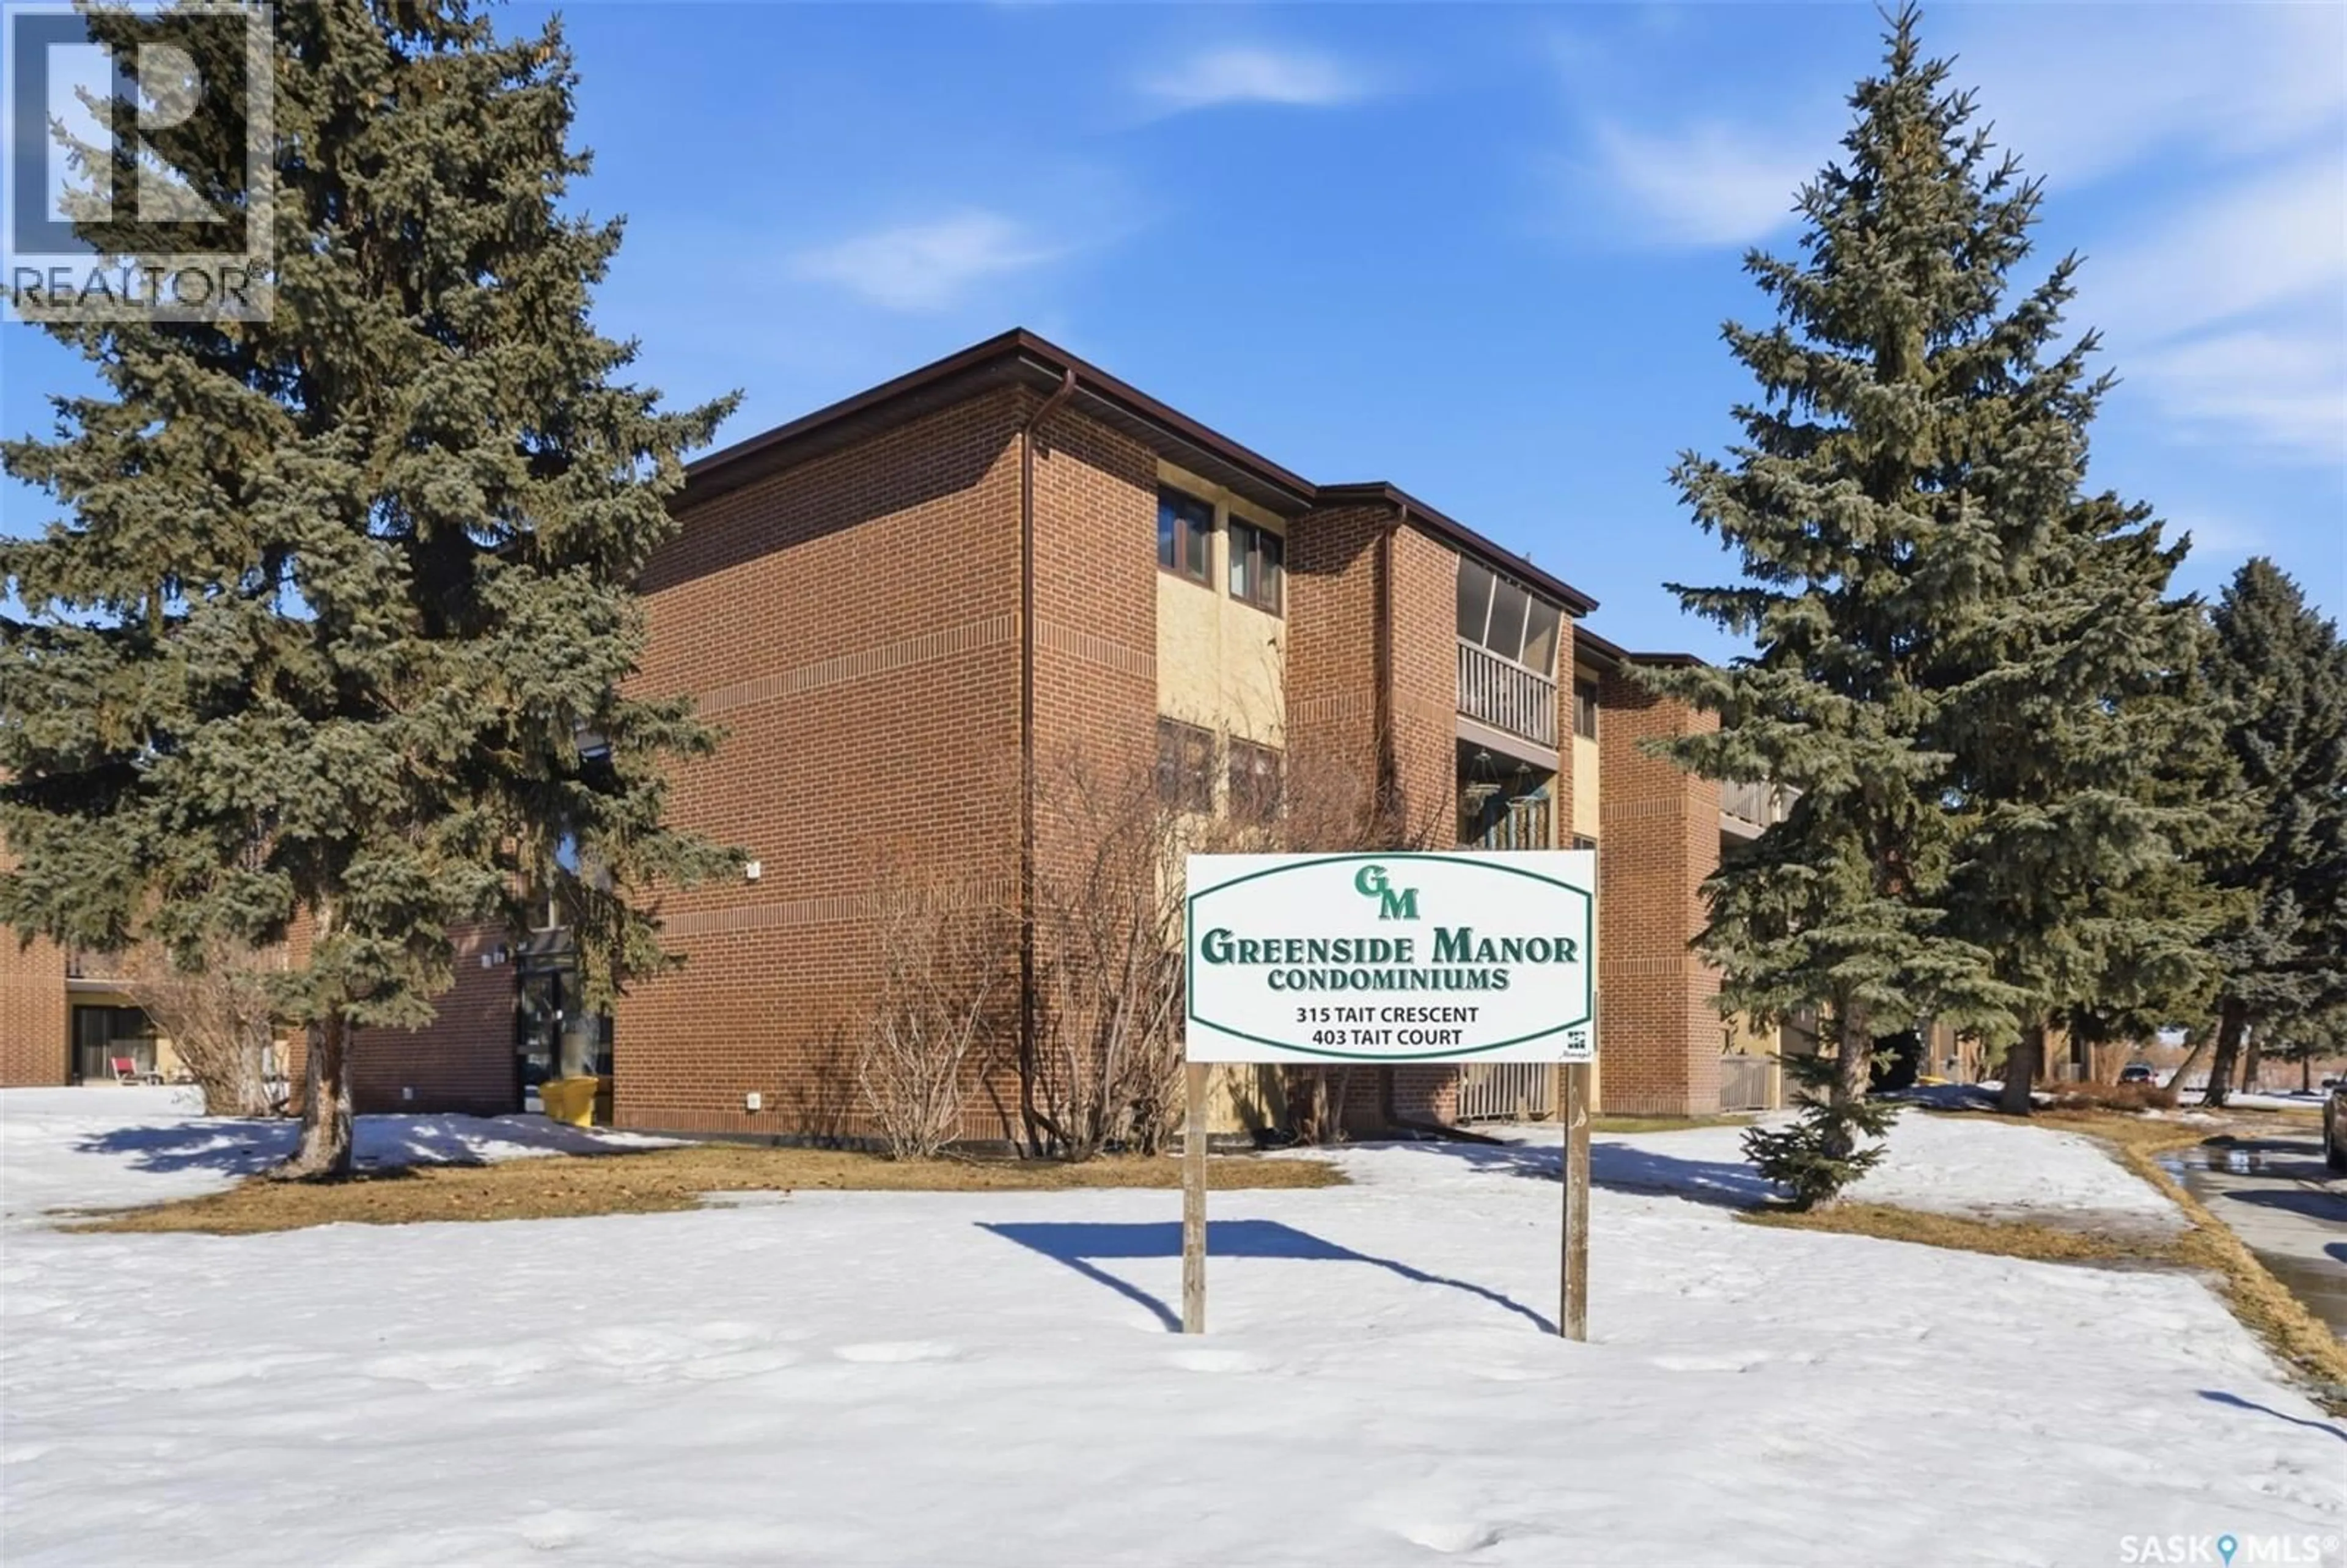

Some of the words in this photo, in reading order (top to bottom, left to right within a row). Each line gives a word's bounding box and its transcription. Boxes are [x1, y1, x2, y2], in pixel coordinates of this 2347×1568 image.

[1201, 928, 1414, 964] GREENSIDE
[1431, 926, 1579, 963] MANOR
[1267, 968, 1510, 991] CONDOMINIUMS
[1296, 1007, 1331, 1023] 315
[1335, 1007, 1375, 1022] TAIT
[1380, 1007, 1479, 1023] CRESCENT
[1312, 1030, 1346, 1045] 403
[1351, 1030, 1392, 1045] TAIT
[1397, 1030, 1463, 1045] COURT
